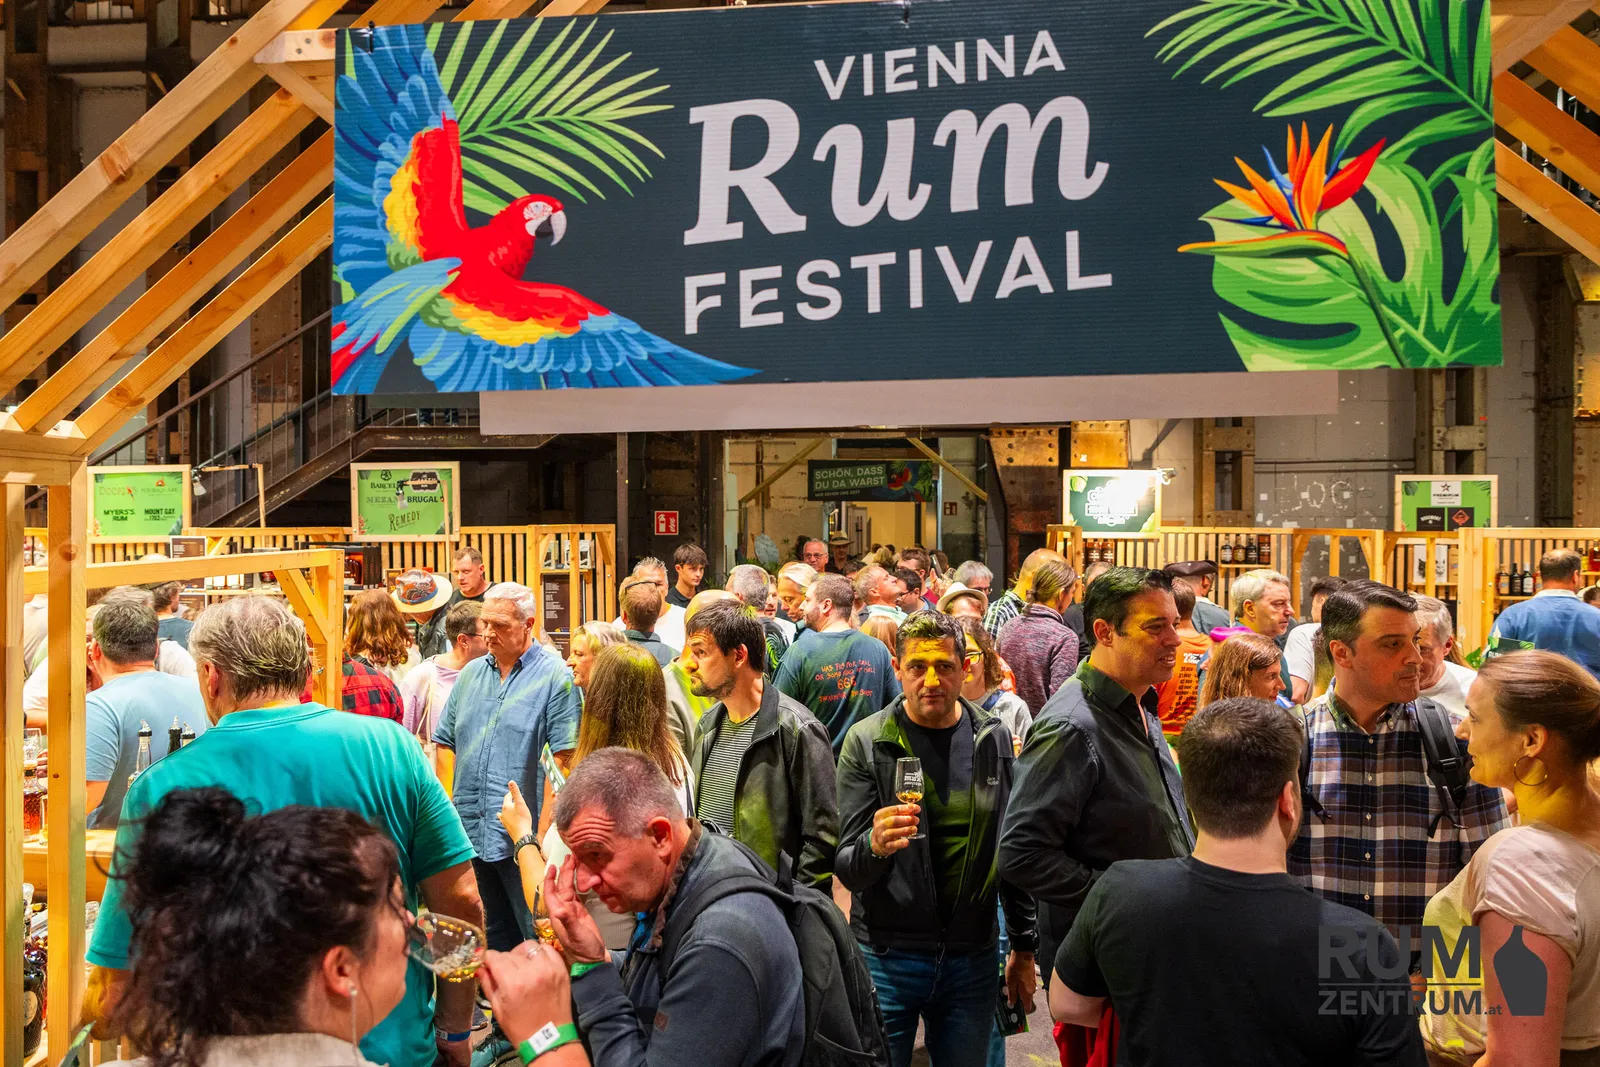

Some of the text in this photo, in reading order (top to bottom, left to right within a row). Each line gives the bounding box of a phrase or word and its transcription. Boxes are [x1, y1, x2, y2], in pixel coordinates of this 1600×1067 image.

[813, 29, 1066, 100] VIENNA
[683, 96, 1110, 246] Rum
[684, 229, 1112, 335] FESTIVAL
[815, 466, 883, 479] SCHÖN, DASS
[815, 476, 884, 490] DU DA WARST
[407, 495, 438, 503] BRUGAL
[388, 510, 421, 532] REMEDY
[837, 676, 856, 690] 666
